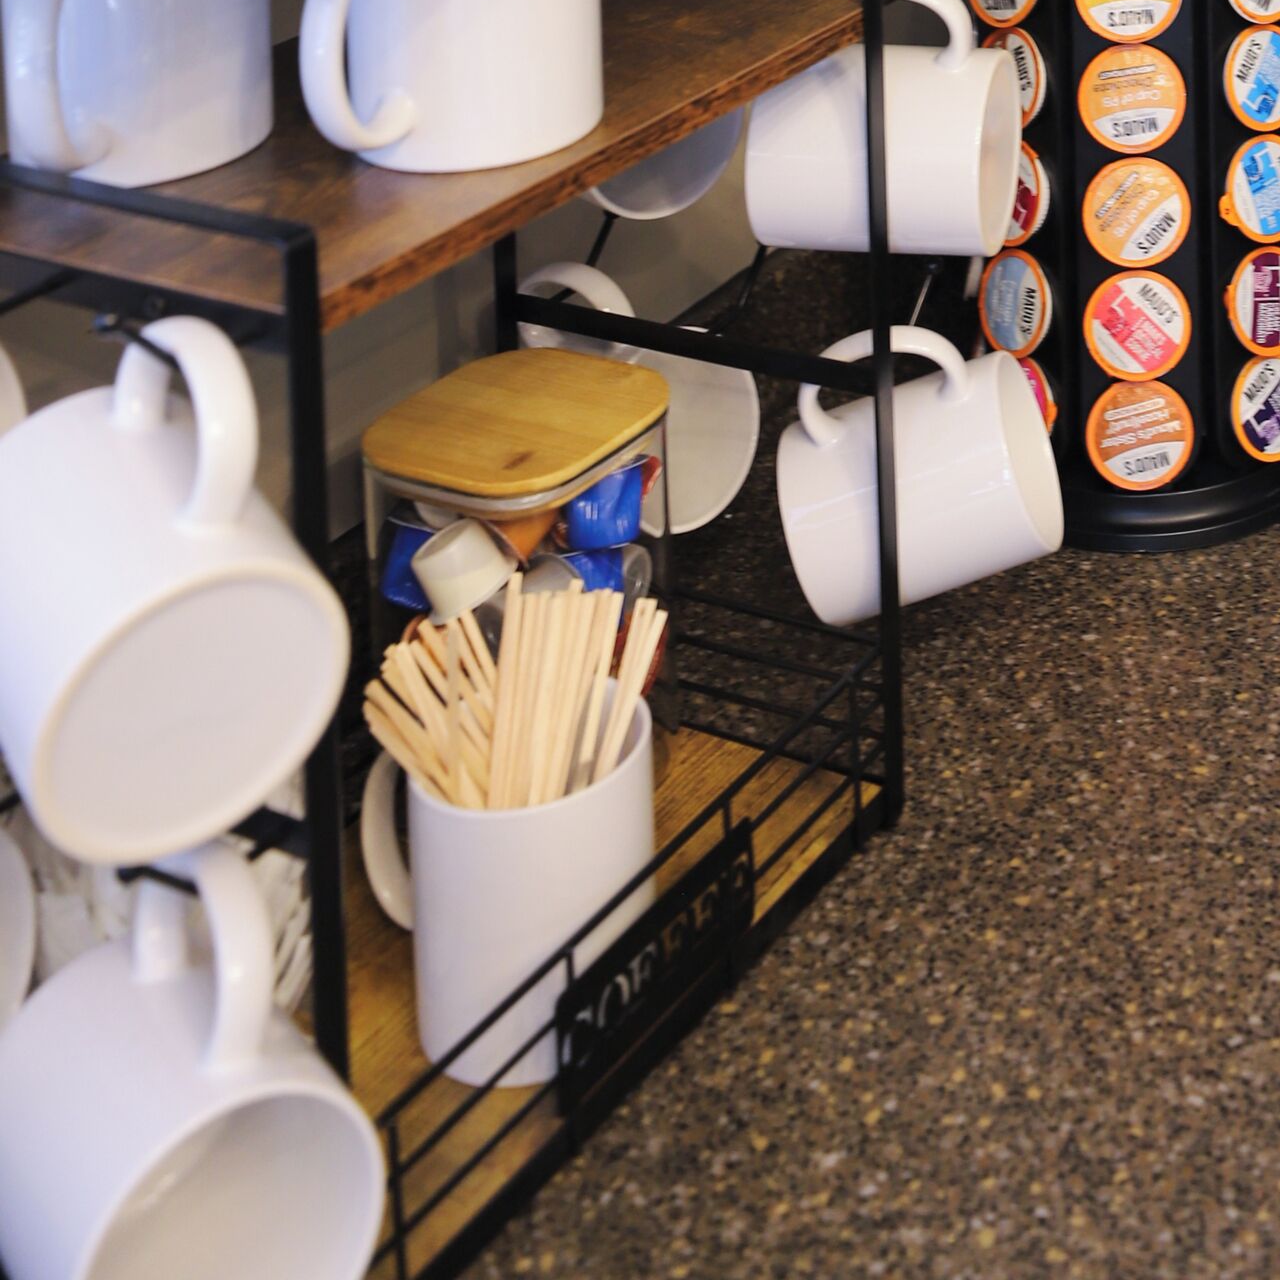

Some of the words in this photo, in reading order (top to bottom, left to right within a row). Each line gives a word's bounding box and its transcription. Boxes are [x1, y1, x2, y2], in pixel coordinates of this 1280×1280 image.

[1106, 9, 1153, 27] MAUD'S
[1013, 44, 1033, 91] MAUD'S
[1236, 40, 1263, 84] MAUD'S
[1111, 116, 1158, 137] MAUD'S
[1135, 209, 1177, 256] MAUD'S
[1022, 286, 1037, 335] MAUD'S
[1136, 281, 1180, 326] MAUD'S
[1122, 451, 1170, 476] MAUD'S
